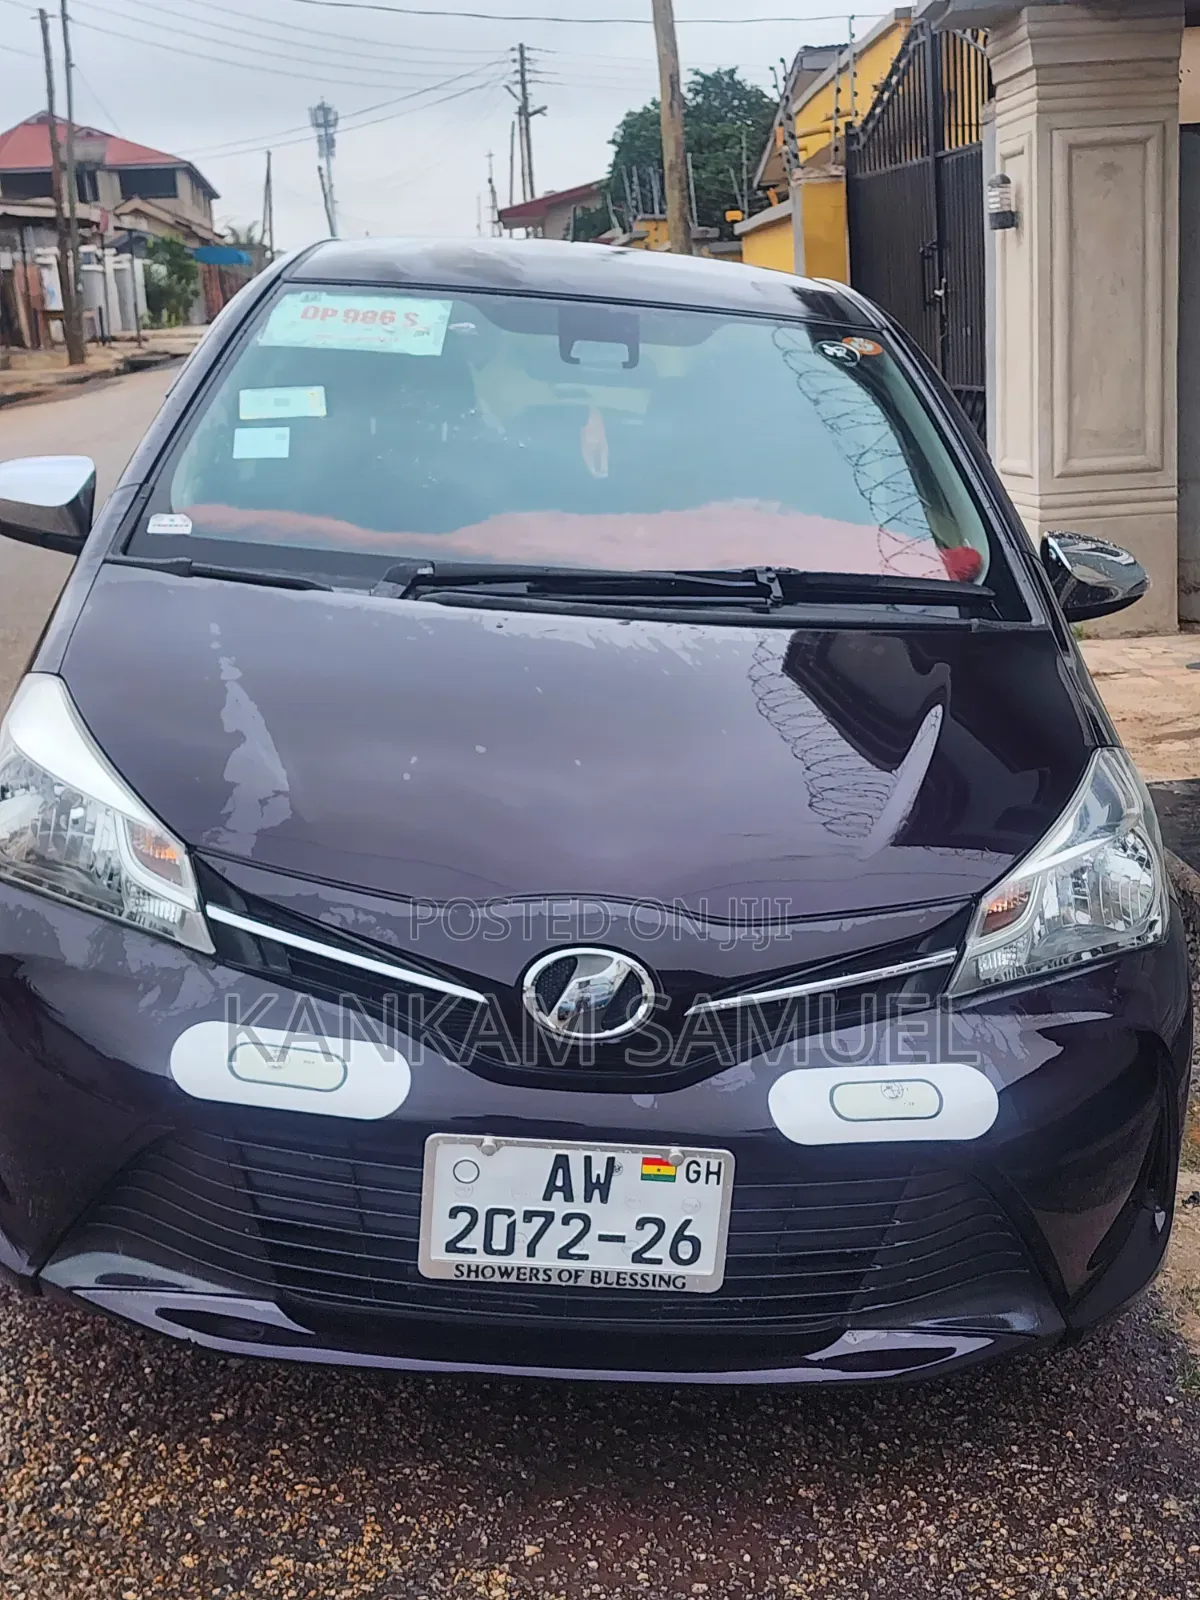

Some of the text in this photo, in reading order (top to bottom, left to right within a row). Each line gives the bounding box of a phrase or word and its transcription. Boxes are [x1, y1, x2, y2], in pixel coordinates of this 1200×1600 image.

[542, 1153, 722, 1205] AW GH
[445, 1205, 702, 1267] 2072-26
[454, 1263, 687, 1290] SHOWERS OF BLESSING
